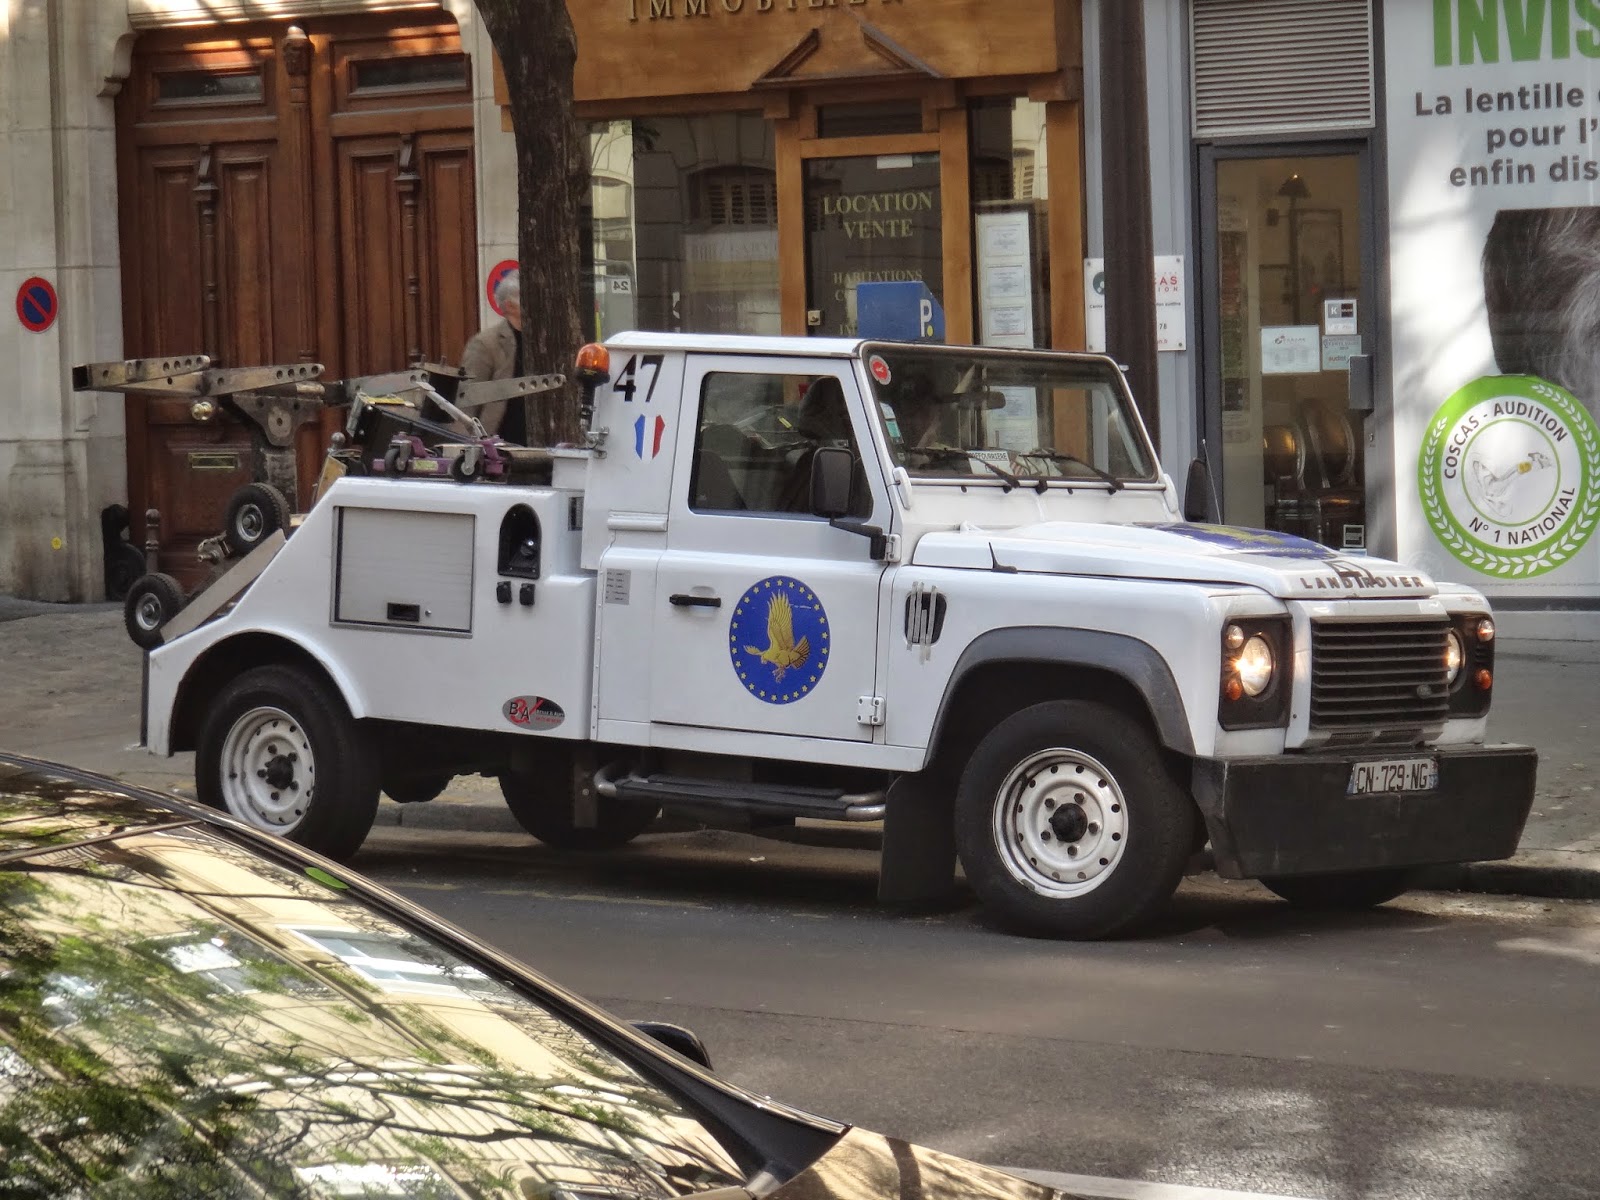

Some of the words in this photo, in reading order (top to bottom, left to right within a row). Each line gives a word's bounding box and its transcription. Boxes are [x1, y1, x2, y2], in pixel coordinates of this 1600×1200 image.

[627, 0, 904, 22] IMMOB
[1415, 91, 1452, 116] La
[1465, 82, 1585, 114] lentille
[1487, 125, 1566, 153] pour
[1449, 158, 1536, 187] enfin
[823, 191, 933, 215] LOCATION
[843, 218, 914, 239] VENTE
[833, 269, 923, 284] HABITATIONS
[613, 354, 665, 402] 47
[1444, 414, 1480, 479] COSCAS
[1493, 401, 1568, 442] AUDITION
[1507, 487, 1576, 545] NATIONAL
